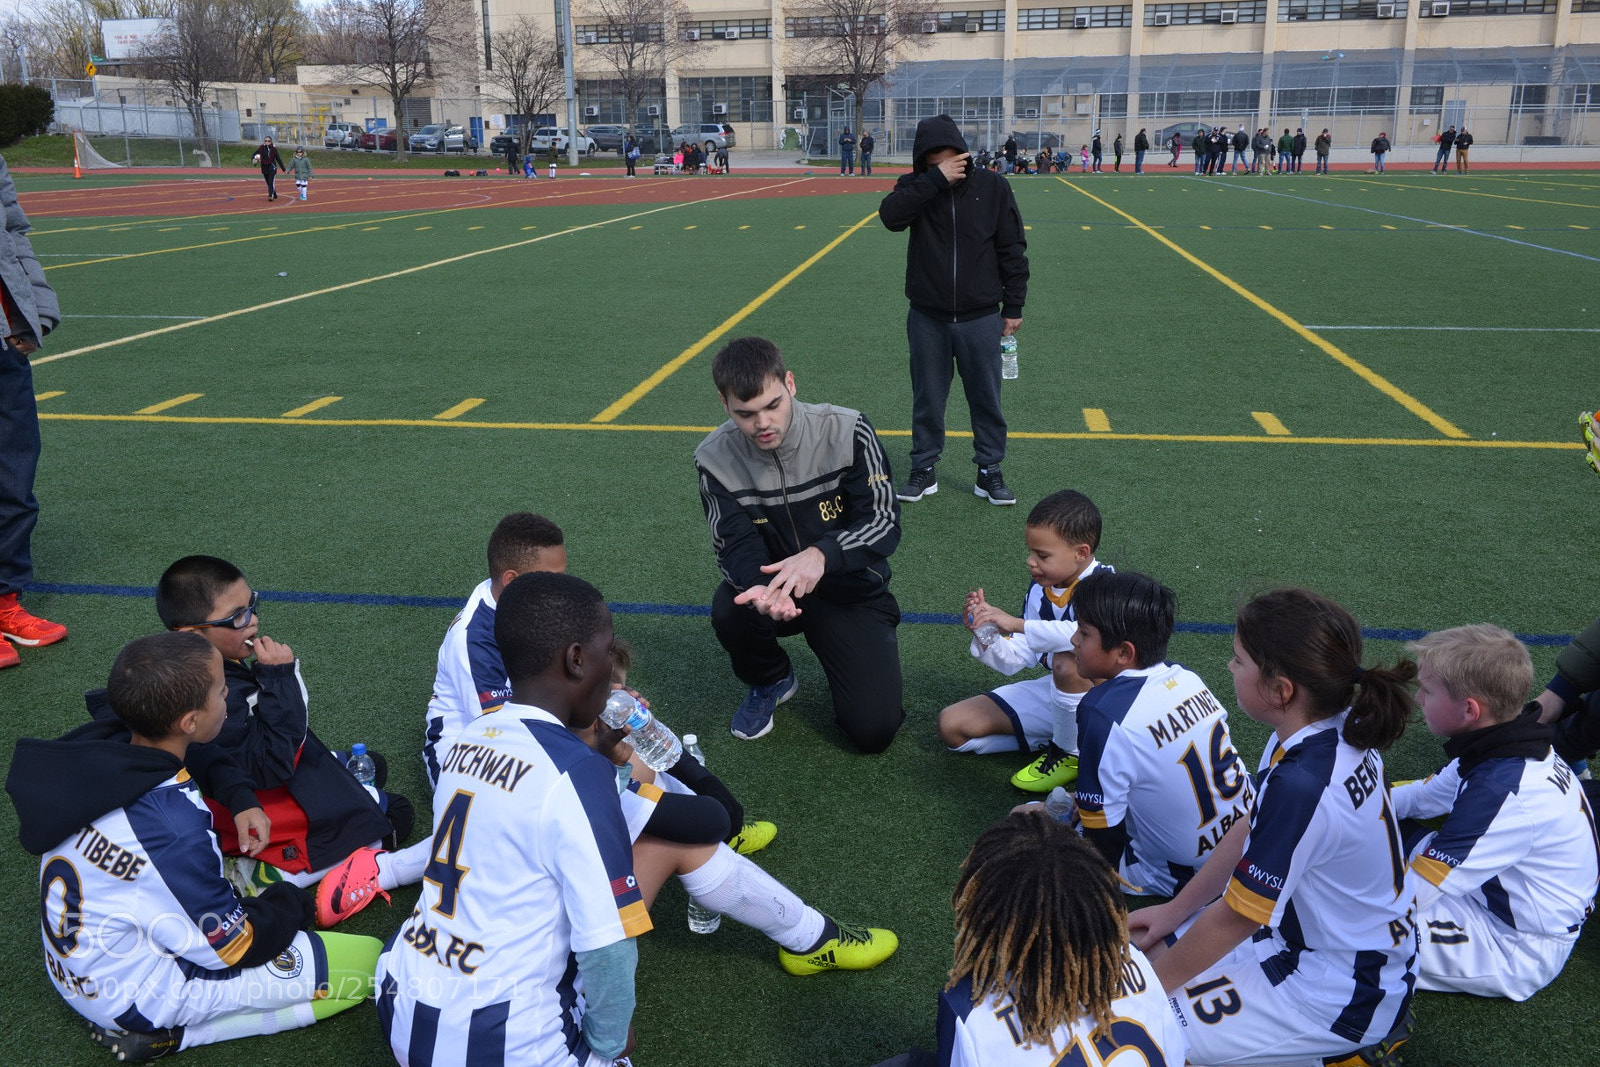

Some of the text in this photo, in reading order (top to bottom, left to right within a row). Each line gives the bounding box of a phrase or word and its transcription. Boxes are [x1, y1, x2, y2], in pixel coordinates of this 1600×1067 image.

[819, 495, 844, 521] 83-C
[442, 743, 535, 793] OTCHWAY
[1176, 719, 1245, 830] 16
[75, 822, 147, 883] TIBEBE
[423, 788, 476, 920] 4
[1252, 866, 1284, 890] WYSL
[444, 933, 485, 976] FC
[807, 958, 840, 969] adidas
[1184, 974, 1242, 1026] 13
